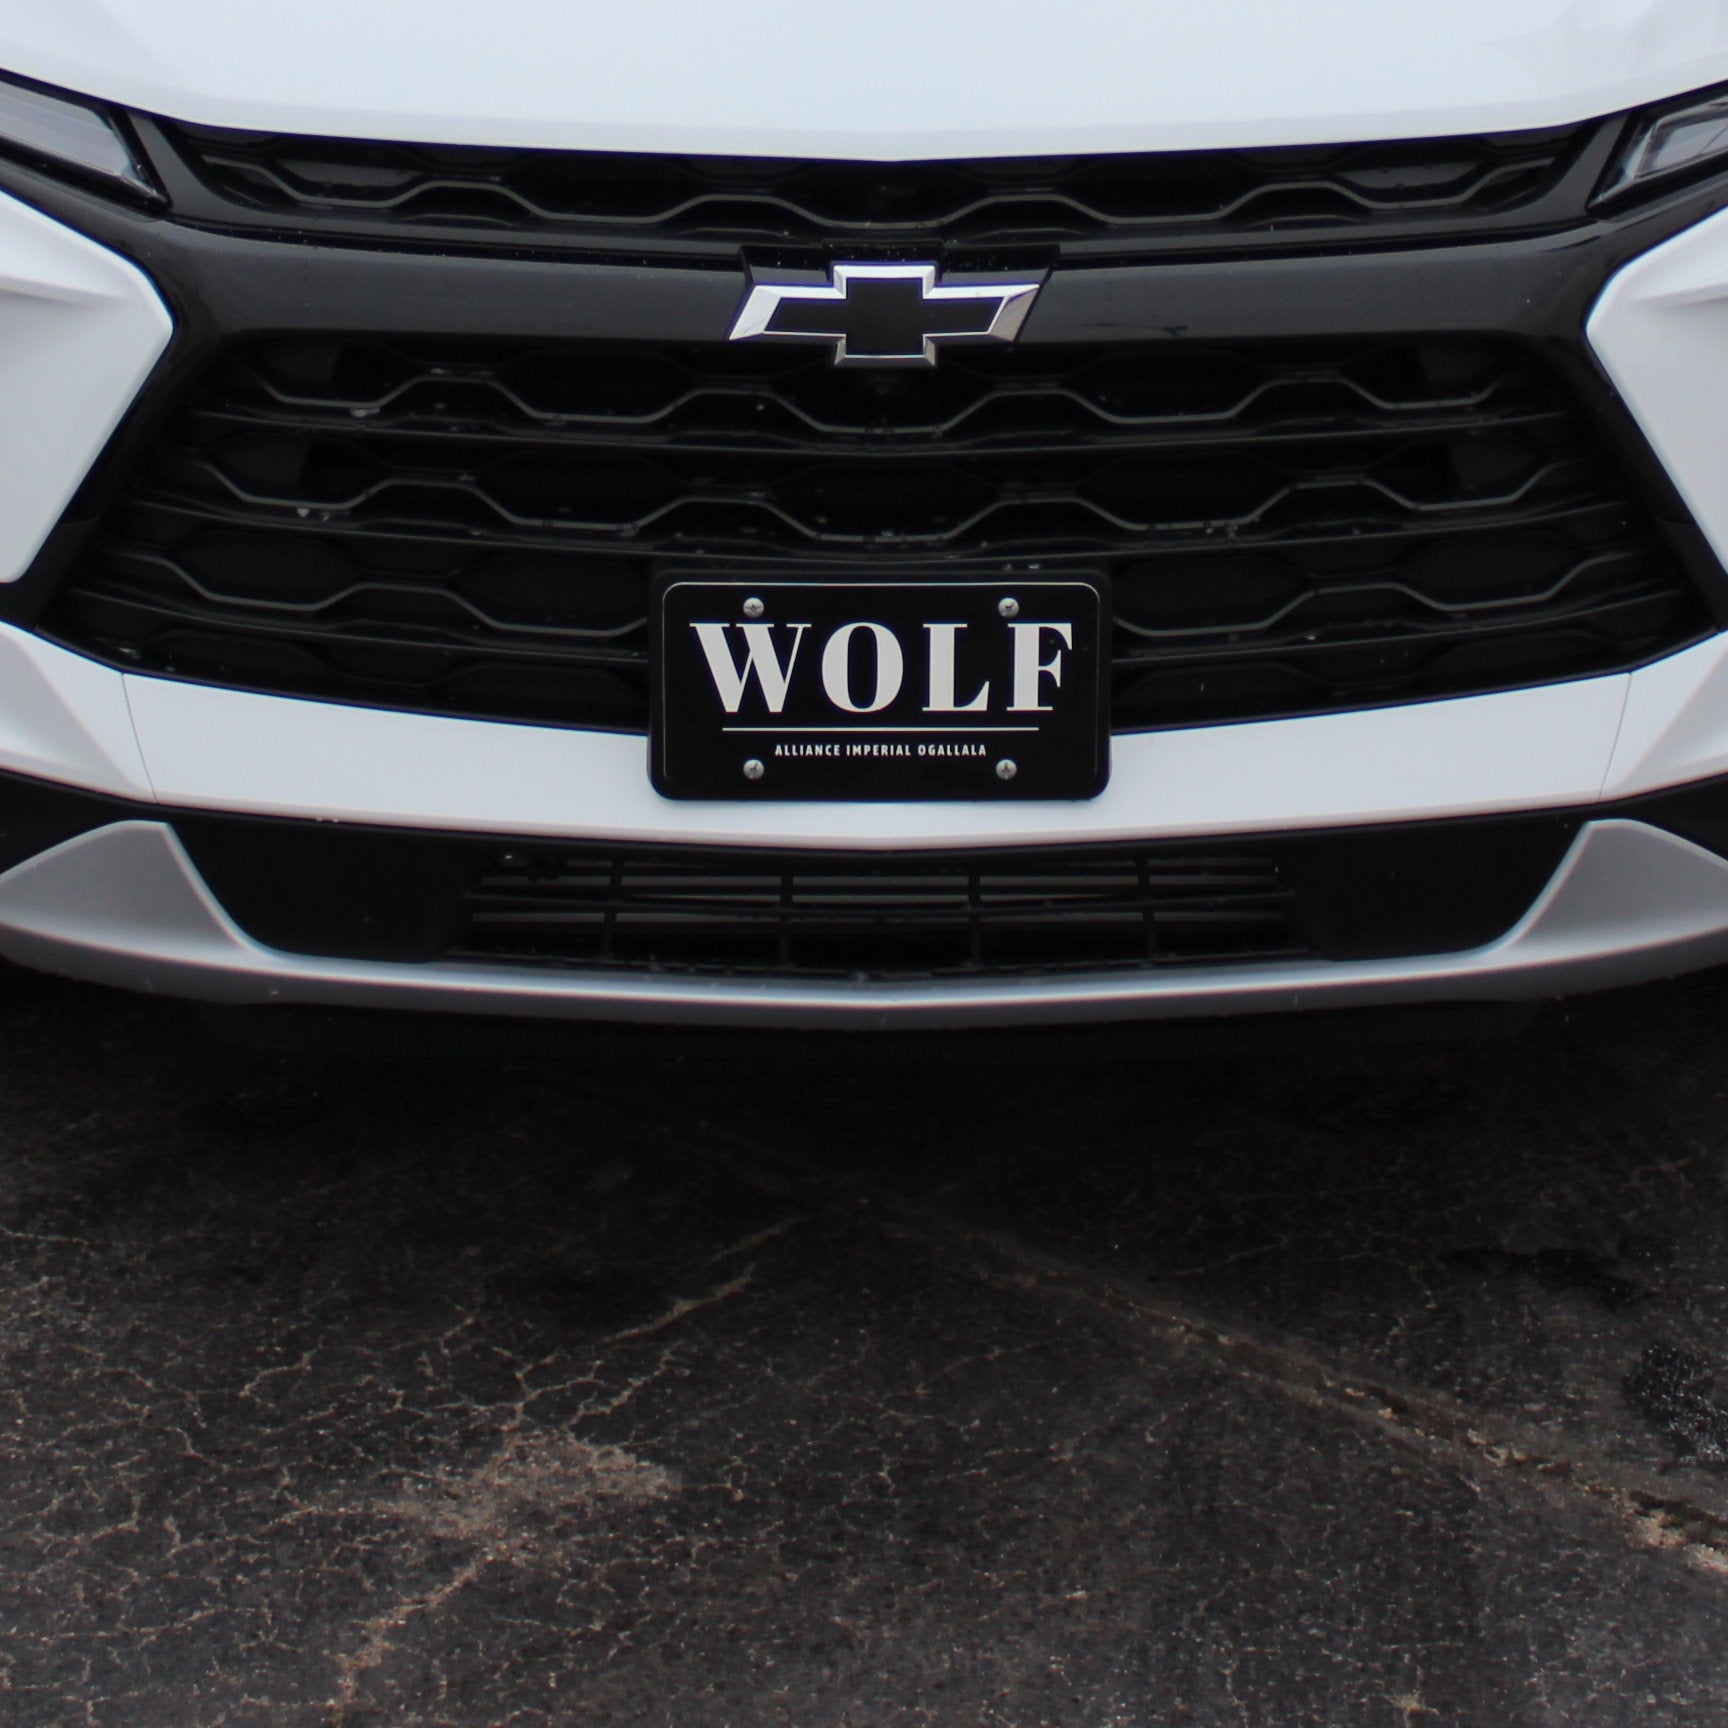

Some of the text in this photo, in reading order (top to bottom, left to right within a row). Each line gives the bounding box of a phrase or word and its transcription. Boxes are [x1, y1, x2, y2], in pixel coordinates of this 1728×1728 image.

[689, 622, 1073, 713] WOLF
[774, 744, 987, 757] ALLIANCE IMPERIAL OGALLALA
